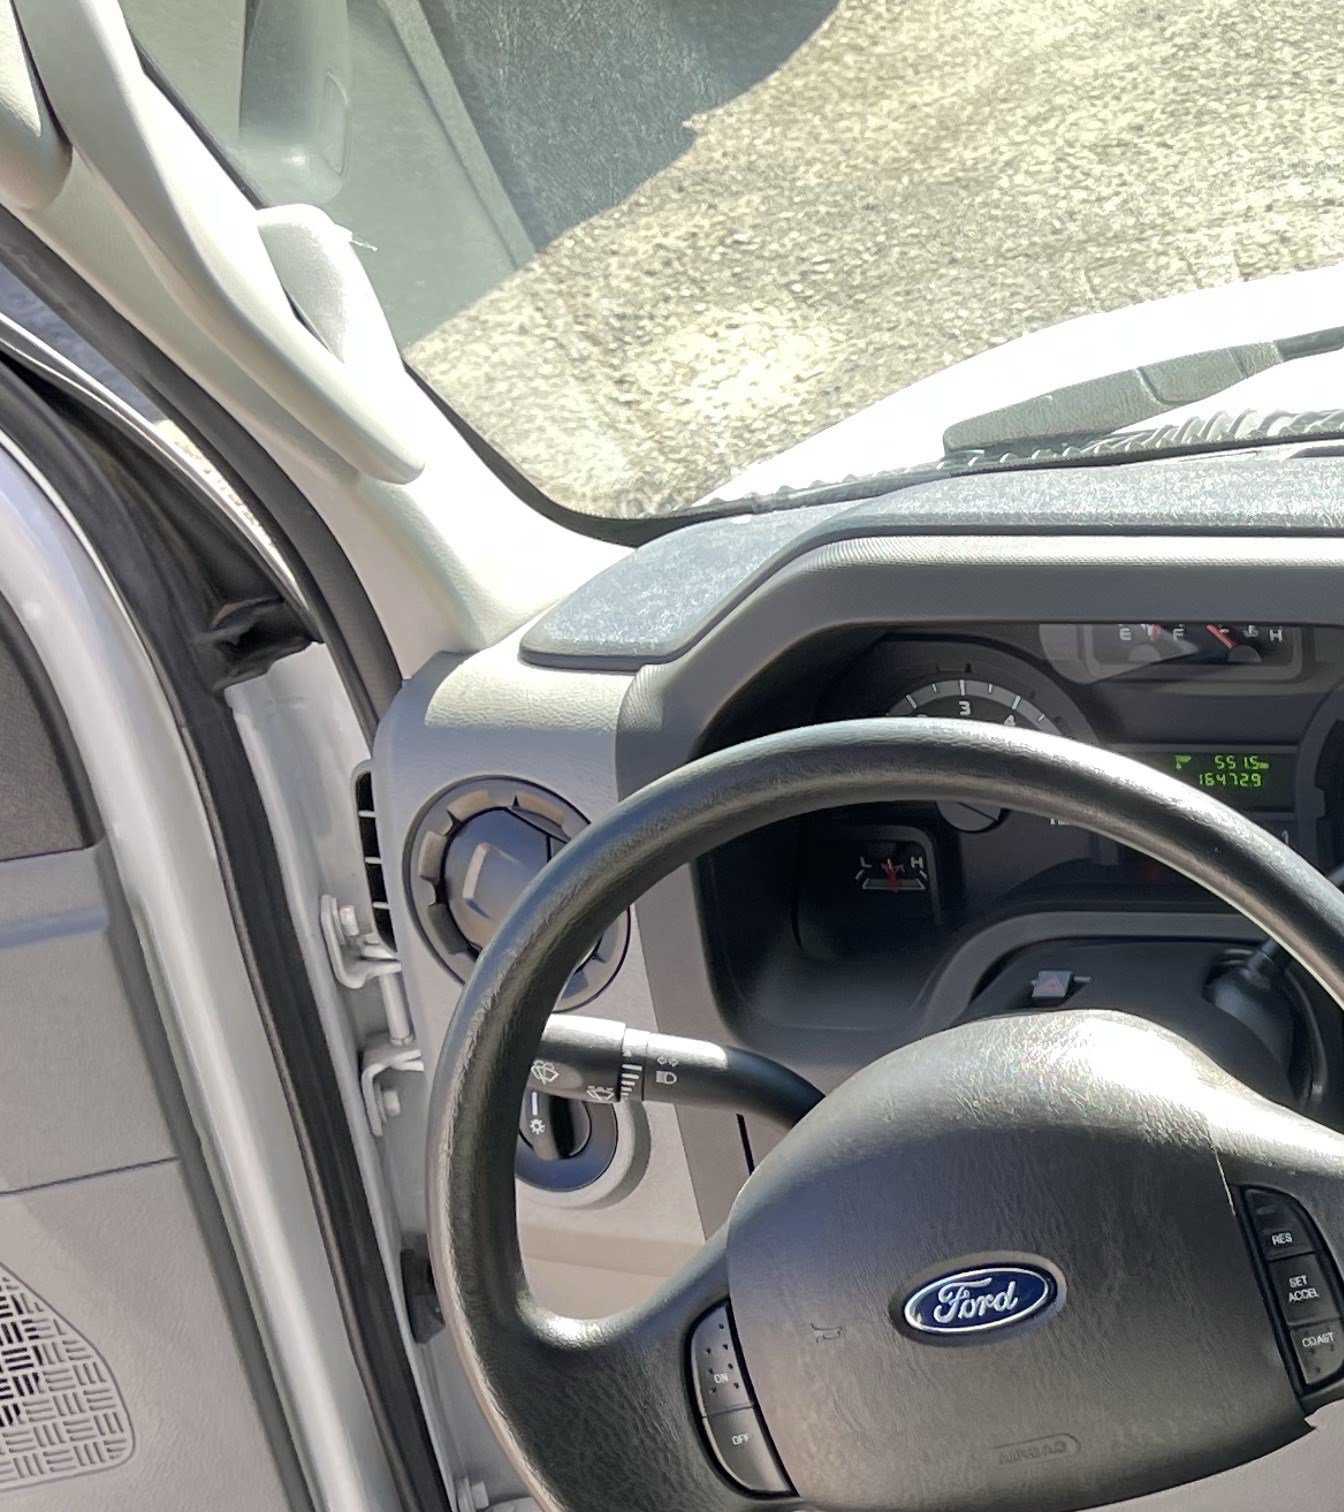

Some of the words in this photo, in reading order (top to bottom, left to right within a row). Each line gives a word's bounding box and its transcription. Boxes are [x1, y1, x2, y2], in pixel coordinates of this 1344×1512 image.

[1119, 627, 1131, 641] E
[1269, 628, 1283, 642] H
[958, 700, 972, 716] 3
[1199, 772, 1262, 787] 164729
[860, 857, 872, 868] L
[911, 856, 924, 868] H
[1271, 1232, 1293, 1245] RES
[1289, 1274, 1308, 1288] SET
[933, 1277, 1019, 1324] Ford
[1288, 1287, 1320, 1302] ACCEL
[1301, 1331, 1335, 1347] COAST
[713, 1372, 729, 1384] ON
[731, 1433, 749, 1446] OFF
